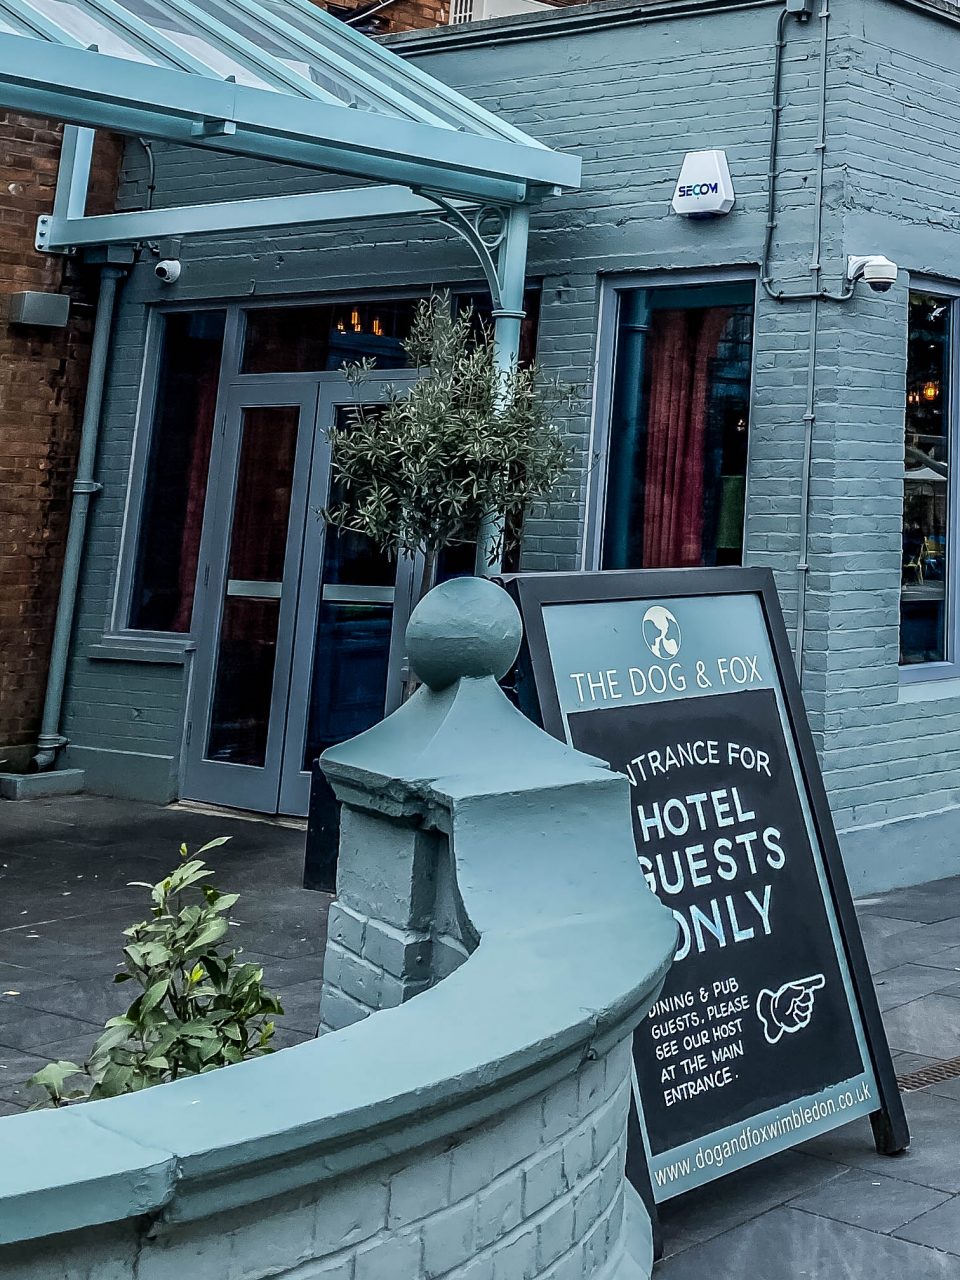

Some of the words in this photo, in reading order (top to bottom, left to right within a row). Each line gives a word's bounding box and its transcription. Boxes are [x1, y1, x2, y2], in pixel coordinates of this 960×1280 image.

[678, 182, 718, 198] SECOM
[570, 669, 623, 703] THE
[628, 663, 688, 697] DOG
[696, 660, 713, 689] &
[717, 655, 764, 686] FOX
[727, 742, 772, 777] FOR
[636, 786, 756, 842] HOTEL
[699, 987, 709, 1003] &
[712, 977, 739, 998] PUB
[706, 995, 751, 1021] PLEASE
[655, 1040, 679, 1061] SEE
[683, 1029, 711, 1051] OUR
[712, 1018, 743, 1042] HOST
[661, 1064, 676, 1083] AT
[679, 1054, 708, 1075] THE
[711, 1039, 745, 1065] MAIN
[654, 1081, 873, 1188] www.dogandfoxwimbledon.co.uk
